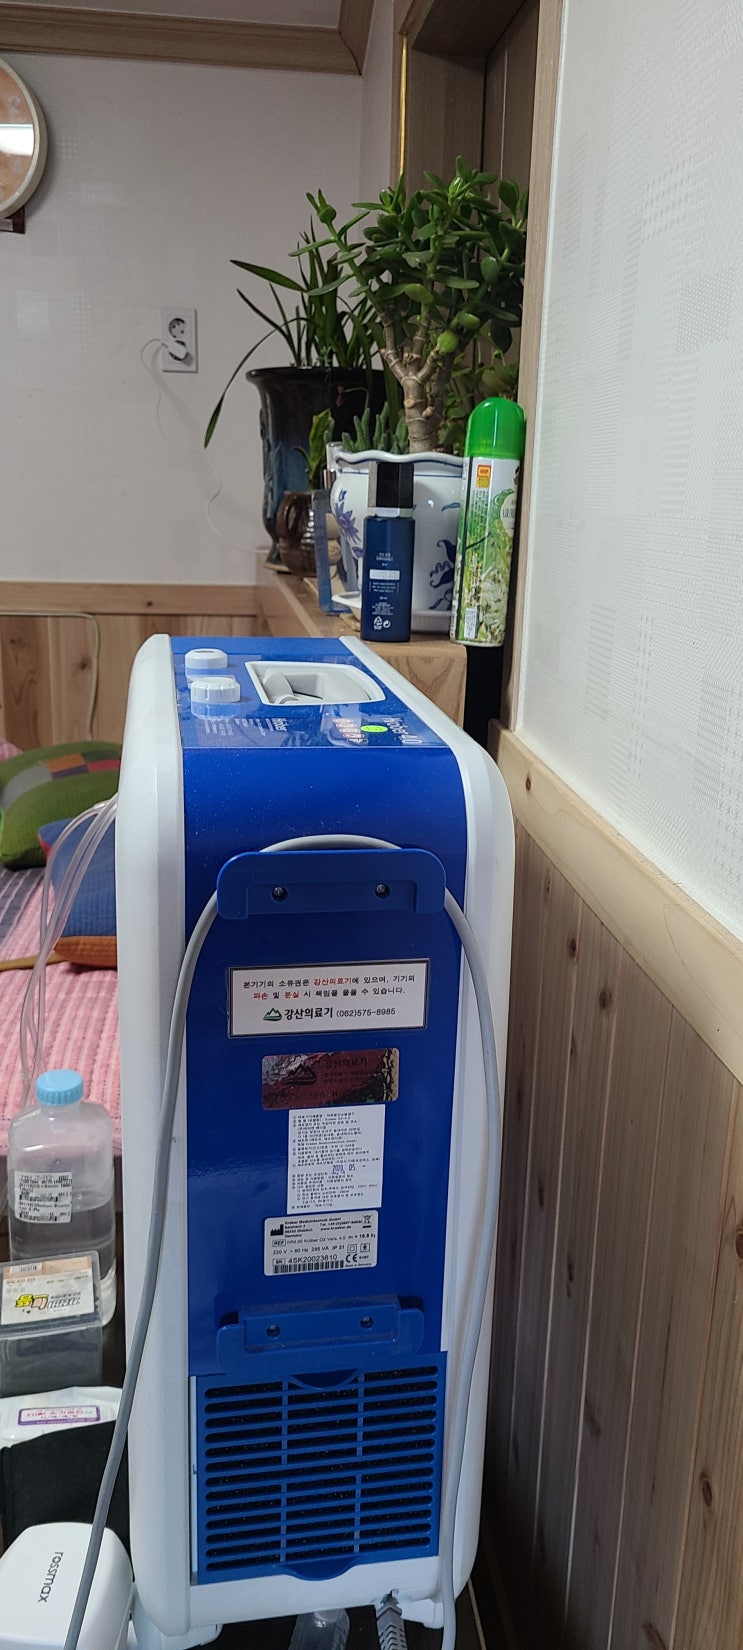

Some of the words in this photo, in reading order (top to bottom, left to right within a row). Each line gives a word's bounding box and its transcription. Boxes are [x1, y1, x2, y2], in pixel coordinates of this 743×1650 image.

[243, 980, 274, 989] 본기기의
[278, 978, 310, 987] 소유권은
[313, 976, 359, 986] 강산의료기에
[363, 975, 389, 984] 있으며,
[392, 974, 415, 983] 기기의
[252, 991, 269, 1000] 파손
[272, 991, 280, 999] 및
[284, 990, 300, 999] 분실
[303, 990, 311, 998] 시
[315, 989, 338, 998] 책임을
[361, 988, 369, 996] 수
[372, 986, 406, 995] 있습니다.
[284, 1007, 333, 1020] 강산의료기
[336, 1007, 396, 1018] (062)575-8985
[37, 1551, 64, 1604] rossmax
